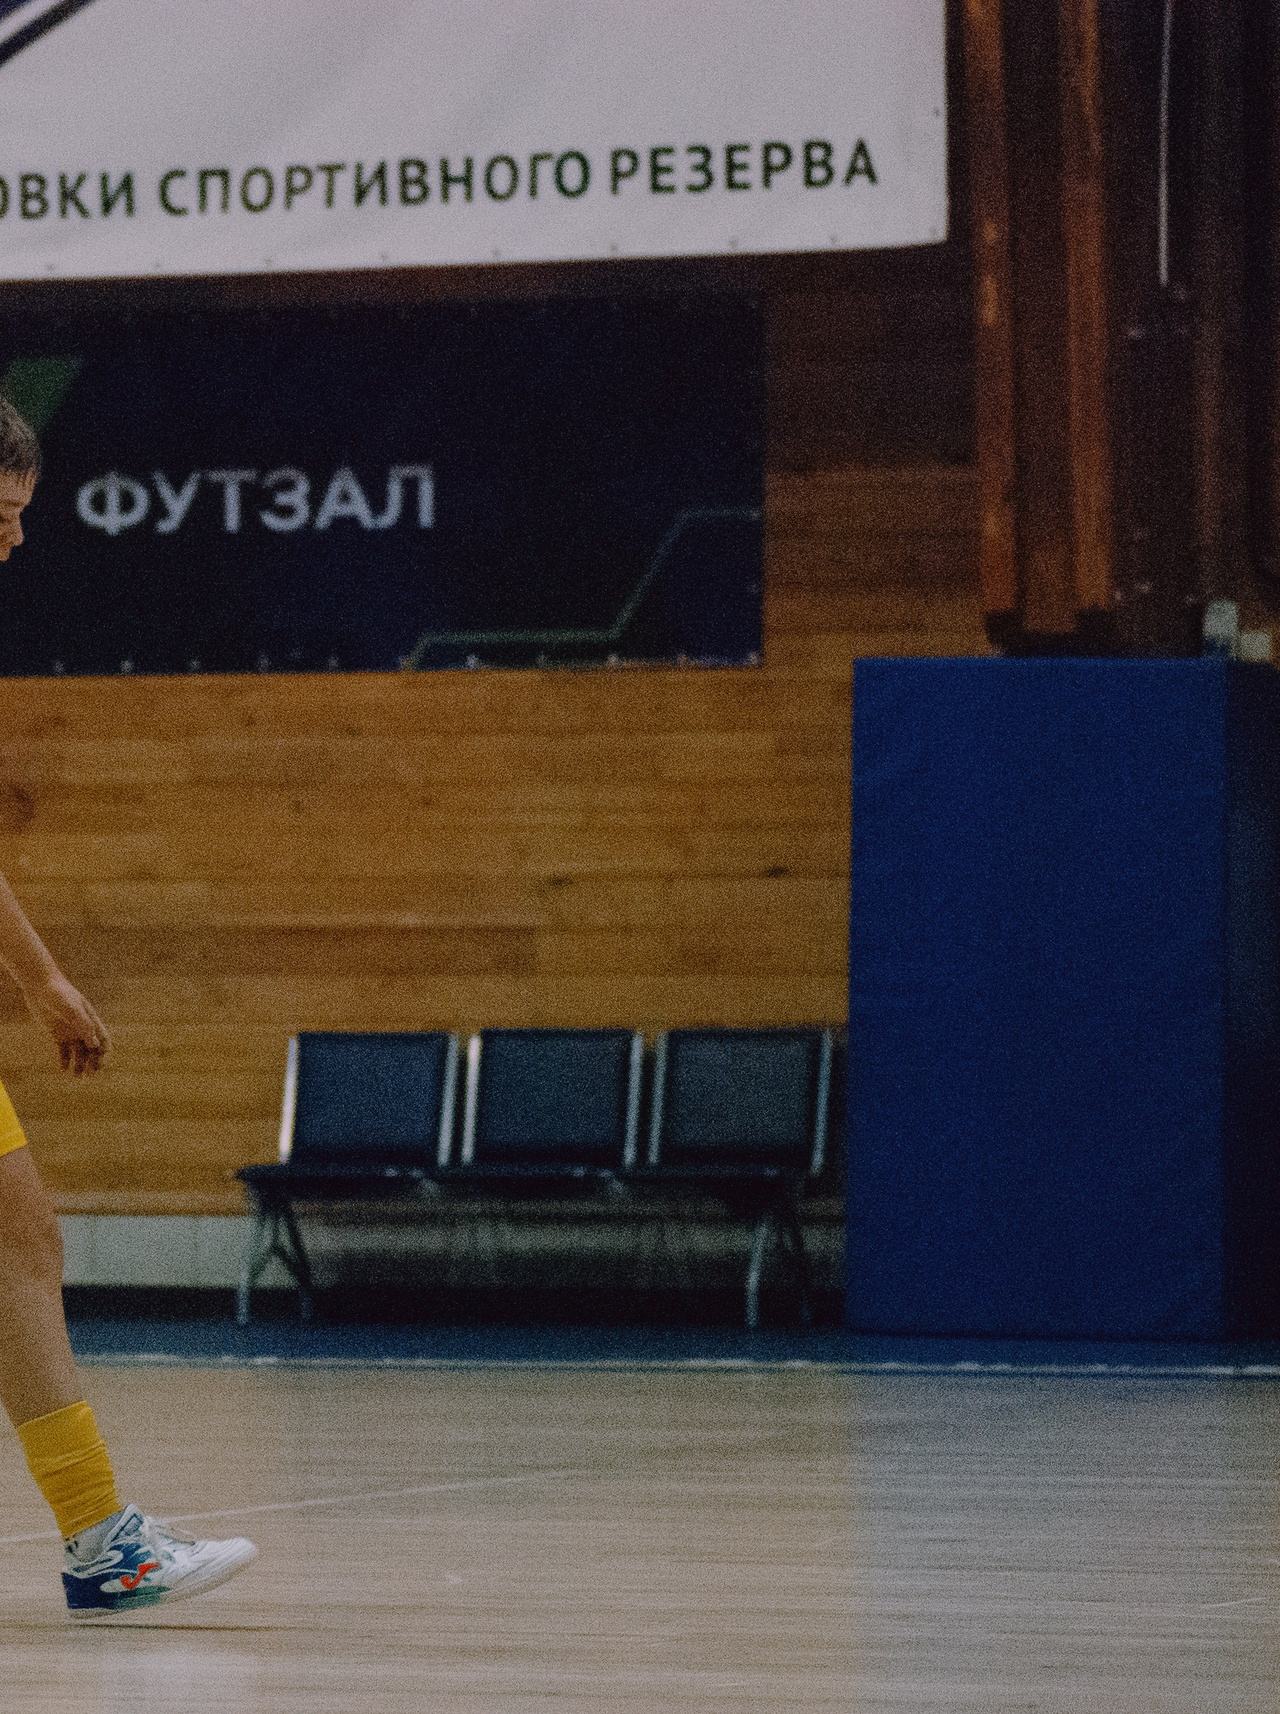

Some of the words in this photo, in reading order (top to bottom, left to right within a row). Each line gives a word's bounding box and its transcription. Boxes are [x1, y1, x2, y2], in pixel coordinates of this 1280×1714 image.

[159, 150, 592, 217] СПОРТИВНОГО
[610, 138, 879, 196] РЕЗЕРВА
[77, 467, 434, 534] ФУТЗАЛ
